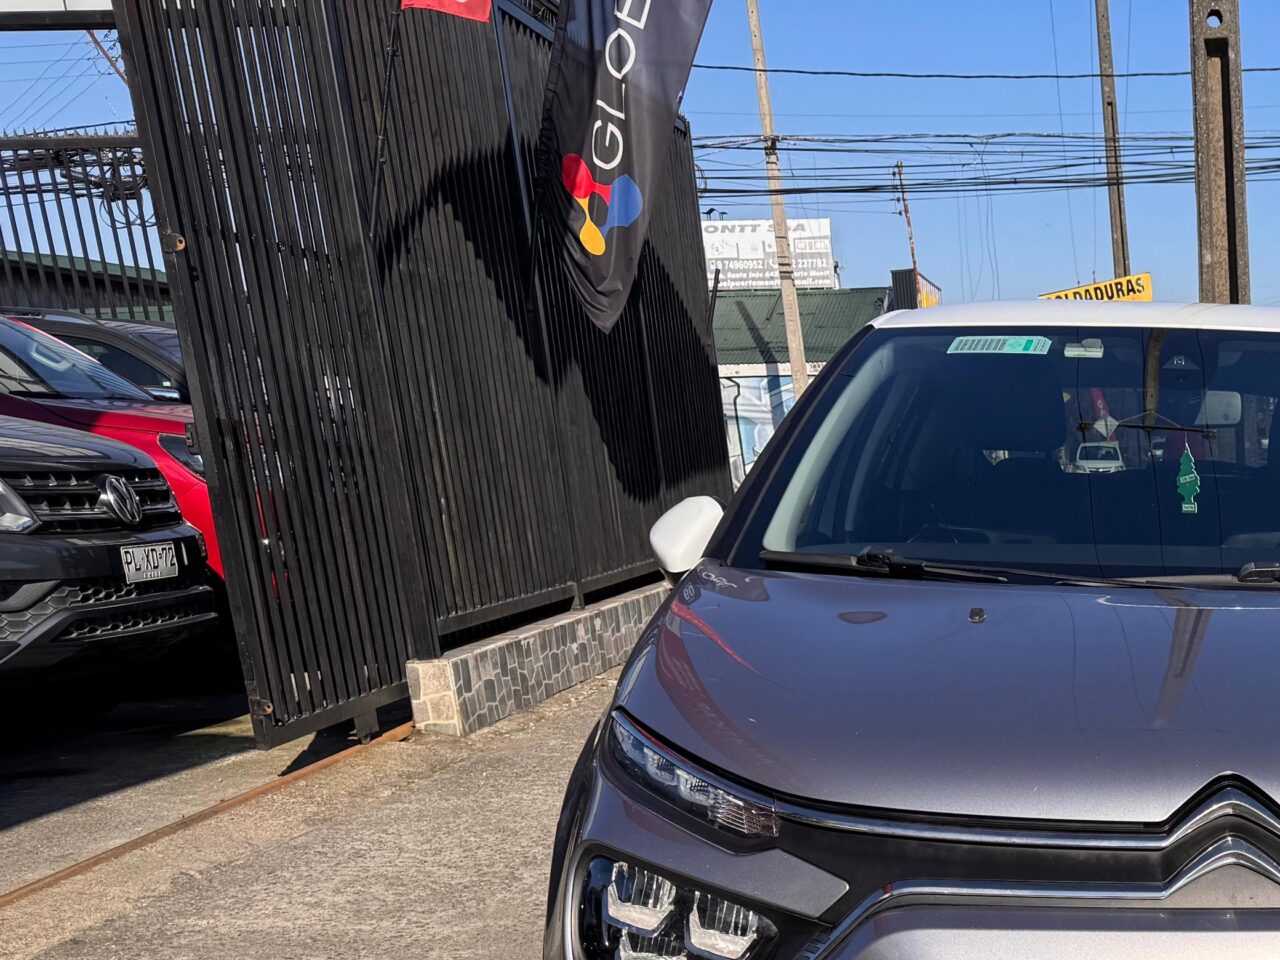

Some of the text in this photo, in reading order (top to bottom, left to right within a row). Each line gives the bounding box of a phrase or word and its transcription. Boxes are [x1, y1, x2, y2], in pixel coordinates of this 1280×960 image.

[704, 223, 806, 233] ONTT SA
[1046, 277, 1145, 301] DADURAS
